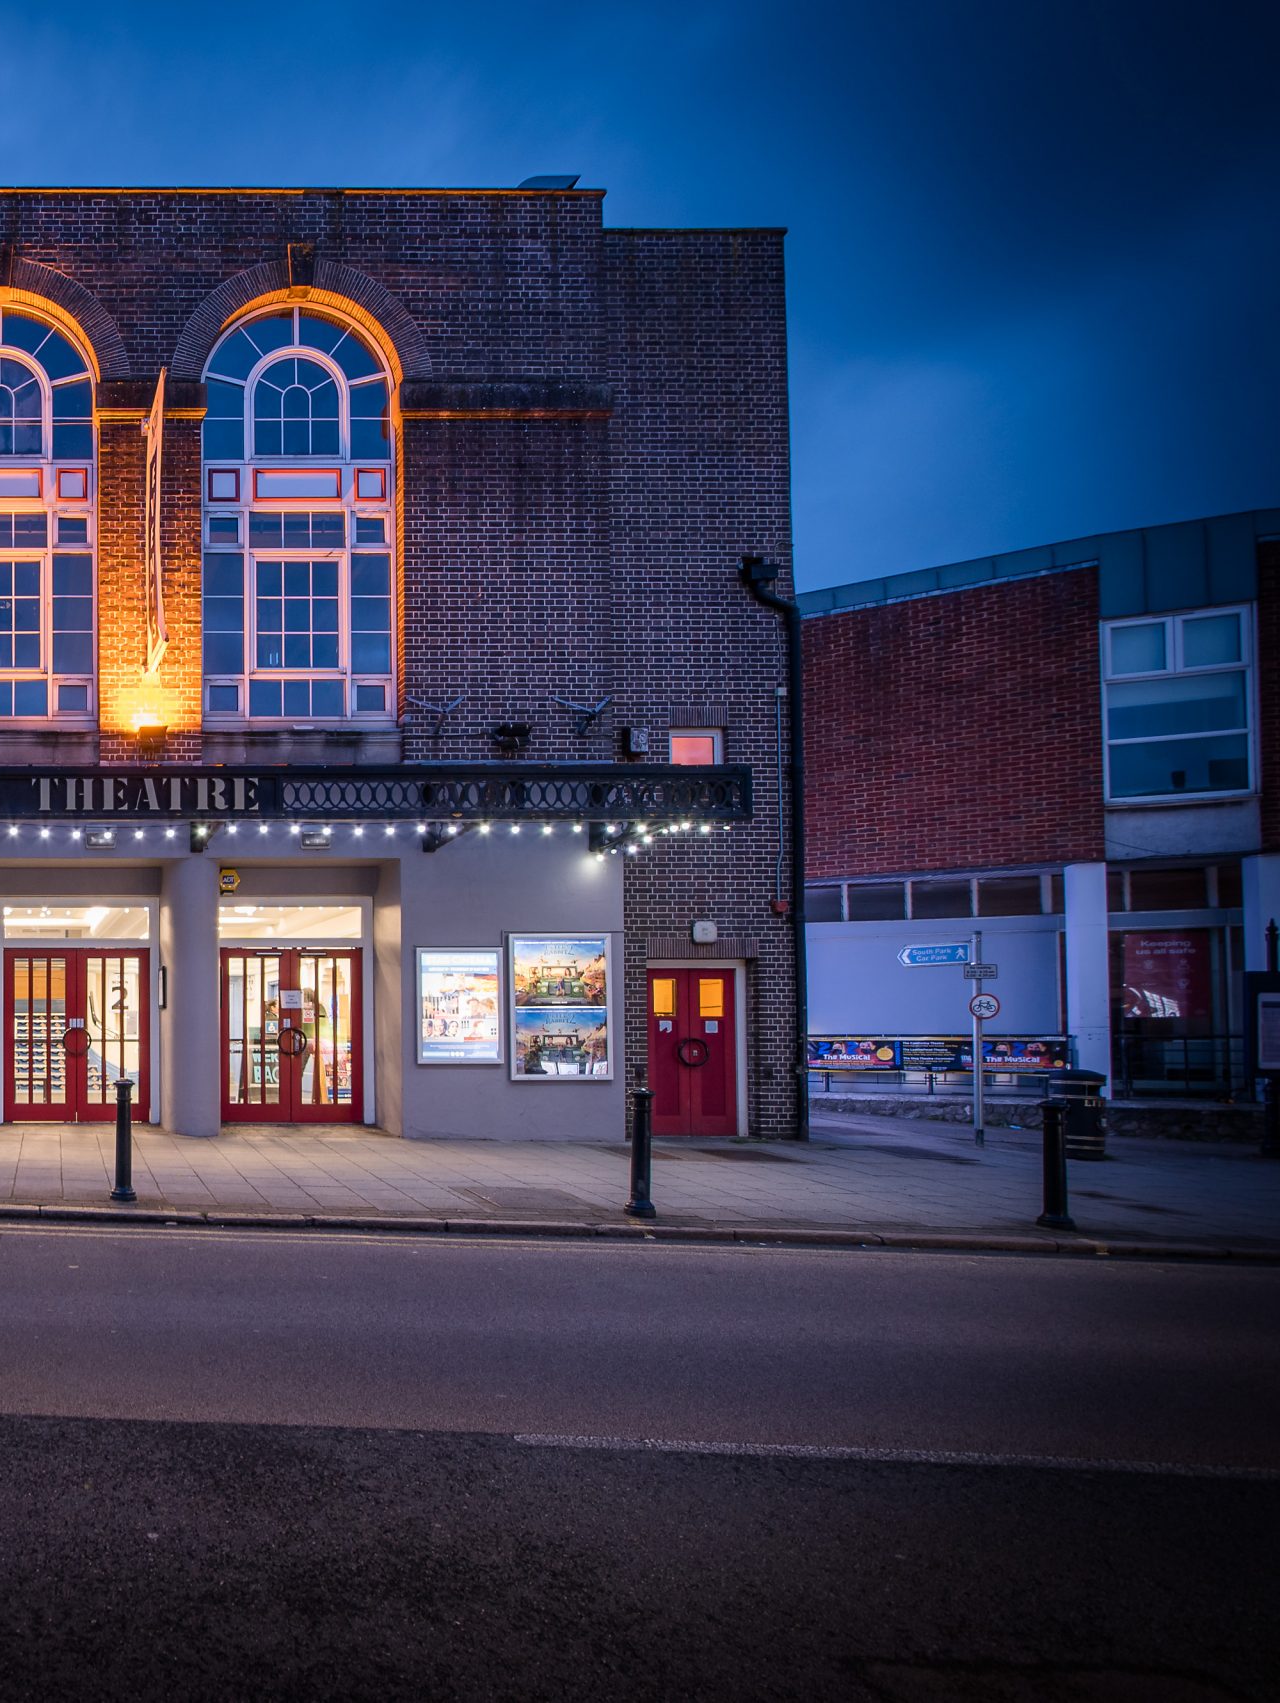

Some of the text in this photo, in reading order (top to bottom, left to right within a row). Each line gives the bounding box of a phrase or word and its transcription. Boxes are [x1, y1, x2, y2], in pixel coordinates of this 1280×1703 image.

[31, 778, 259, 811] THEATRE
[912, 948, 934, 956] South
[1140, 940, 1192, 948] Keeping
[112, 986, 128, 1010] 2
